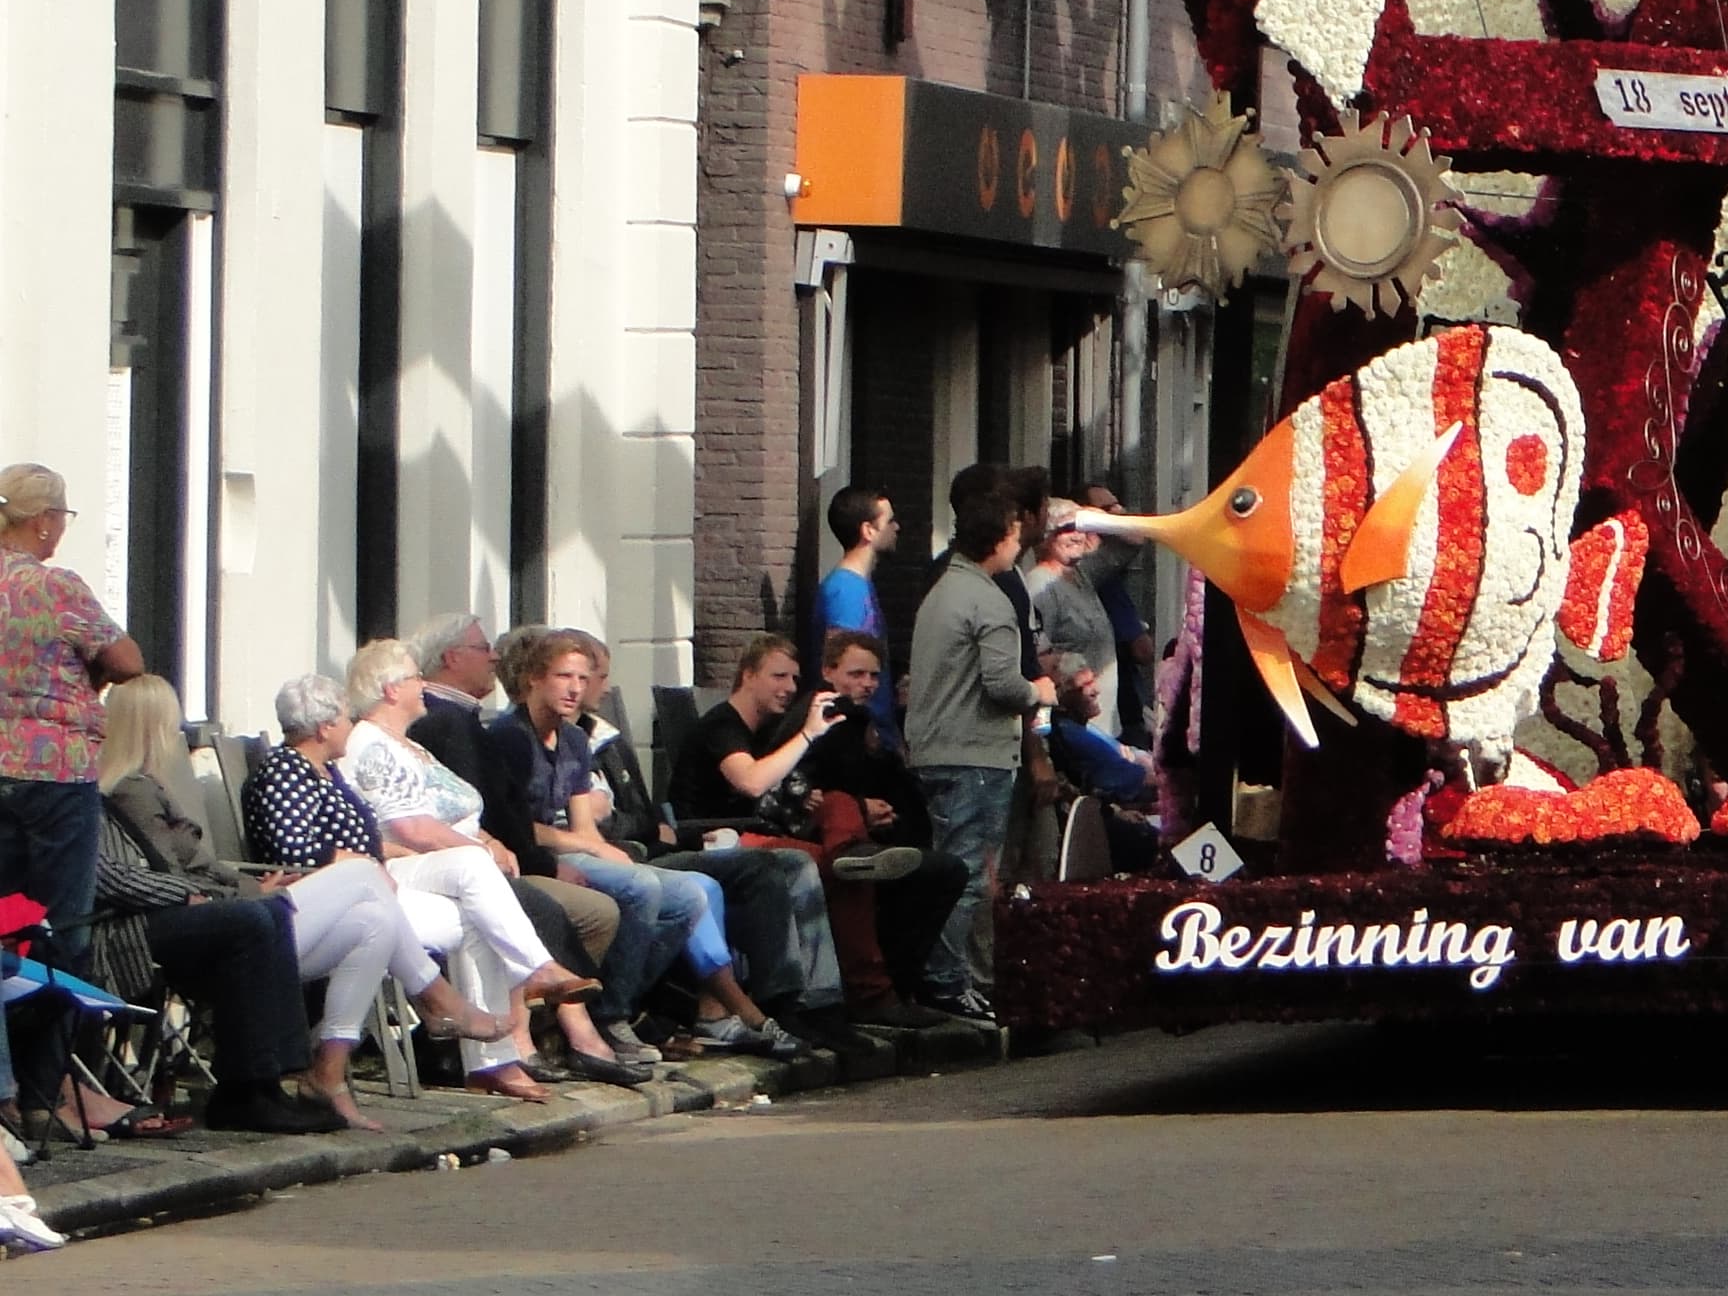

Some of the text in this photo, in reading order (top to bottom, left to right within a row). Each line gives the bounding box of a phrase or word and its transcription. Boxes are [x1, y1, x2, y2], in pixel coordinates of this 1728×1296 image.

[1614, 77, 1653, 114] 18
[1200, 843, 1217, 874] 8
[1156, 901, 1514, 992] Bezinning
[1557, 910, 1691, 963] van
